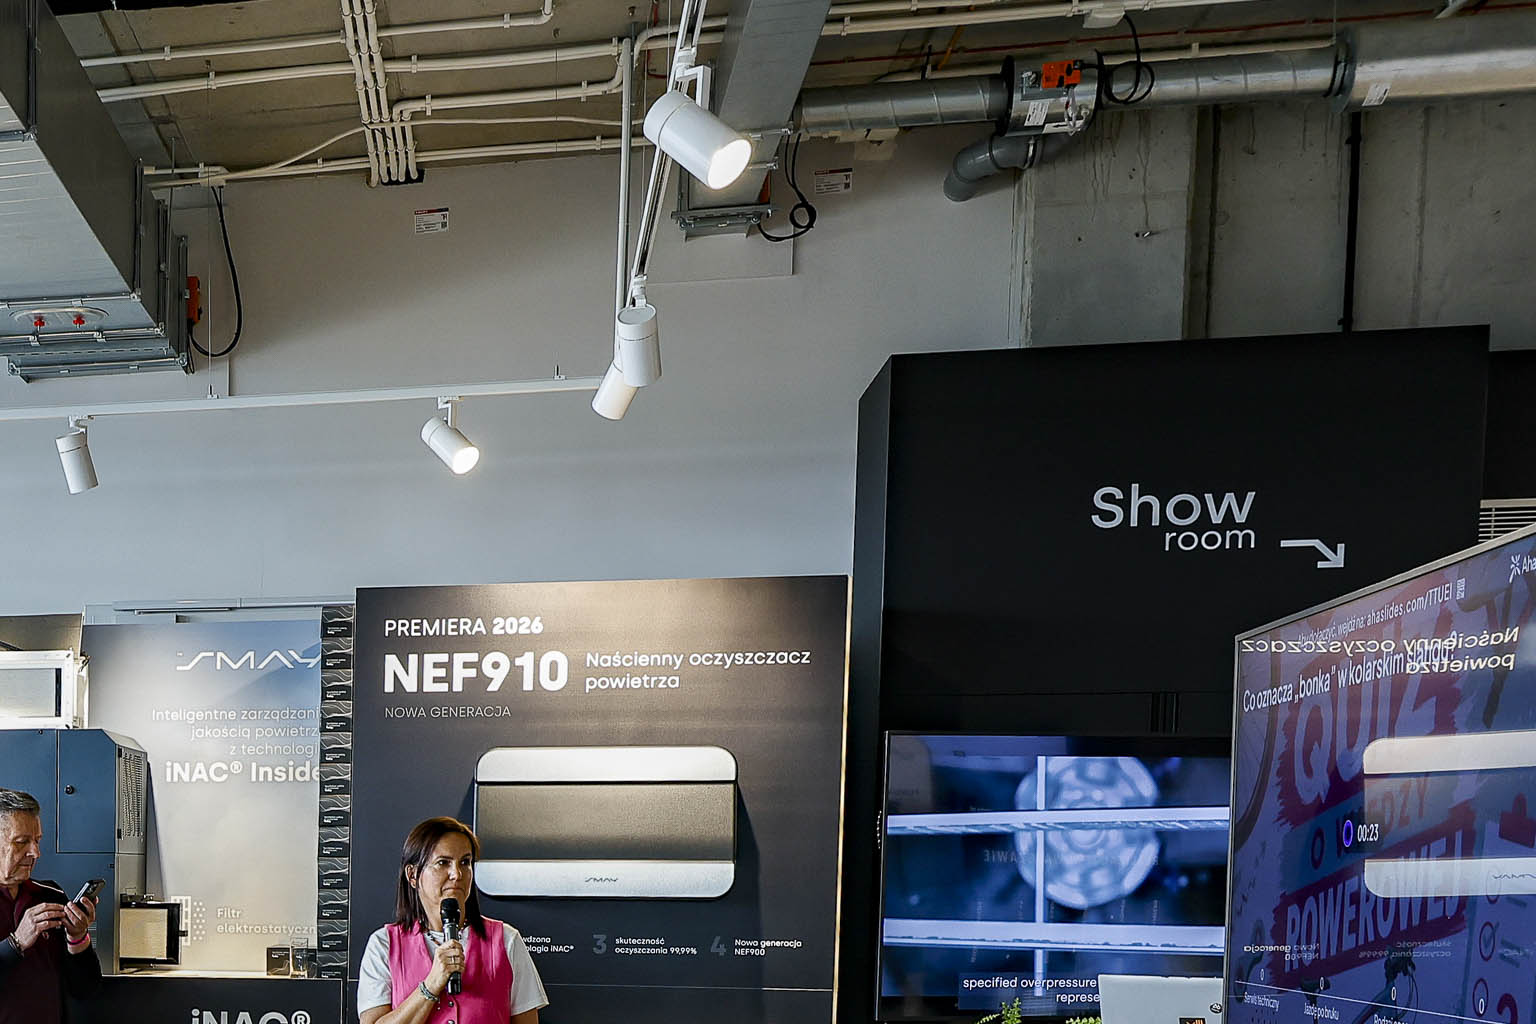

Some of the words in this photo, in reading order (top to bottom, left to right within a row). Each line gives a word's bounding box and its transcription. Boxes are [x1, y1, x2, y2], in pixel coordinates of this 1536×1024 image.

[1091, 483, 1256, 528] Show
[1164, 528, 1255, 551] room
[1522, 556, 1536, 574] Aha
[384, 618, 487, 637] PREMIERA
[492, 616, 544, 635] 2026
[586, 651, 684, 670] Naścienny
[689, 651, 811, 669] oczyszczacz
[384, 650, 569, 692] NEF910
[585, 673, 680, 693] powietrza
[1257, 683, 1293, 708] oznacza
[1337, 669, 1348, 689] w
[1348, 652, 1404, 686] kolarskim
[152, 709, 237, 724] Inteligentne
[241, 706, 321, 724] zarządzani
[384, 706, 426, 718] NOWA
[430, 705, 511, 718] GENERACJA
[191, 724, 251, 740] jakością
[255, 725, 320, 740] powietrz
[229, 745, 236, 755] z
[241, 743, 320, 758] technologi
[165, 760, 243, 783] iNAC®
[1357, 822, 1380, 843] 00:23
[216, 907, 242, 920] Filtr
[216, 922, 317, 936] elektrostatyczn
[523, 935, 551, 943] wdzona
[592, 934, 607, 954] 3
[615, 936, 665, 946] skuteczność
[734, 939, 759, 947] Nowa
[760, 939, 802, 949] generacja
[526, 945, 549, 954] ologia
[615, 946, 668, 956] oczyszczania
[734, 948, 765, 956] NEF900
[963, 976, 1018, 990] specified
[1020, 979, 1097, 991] overpressure
[1056, 993, 1101, 1005] represe
